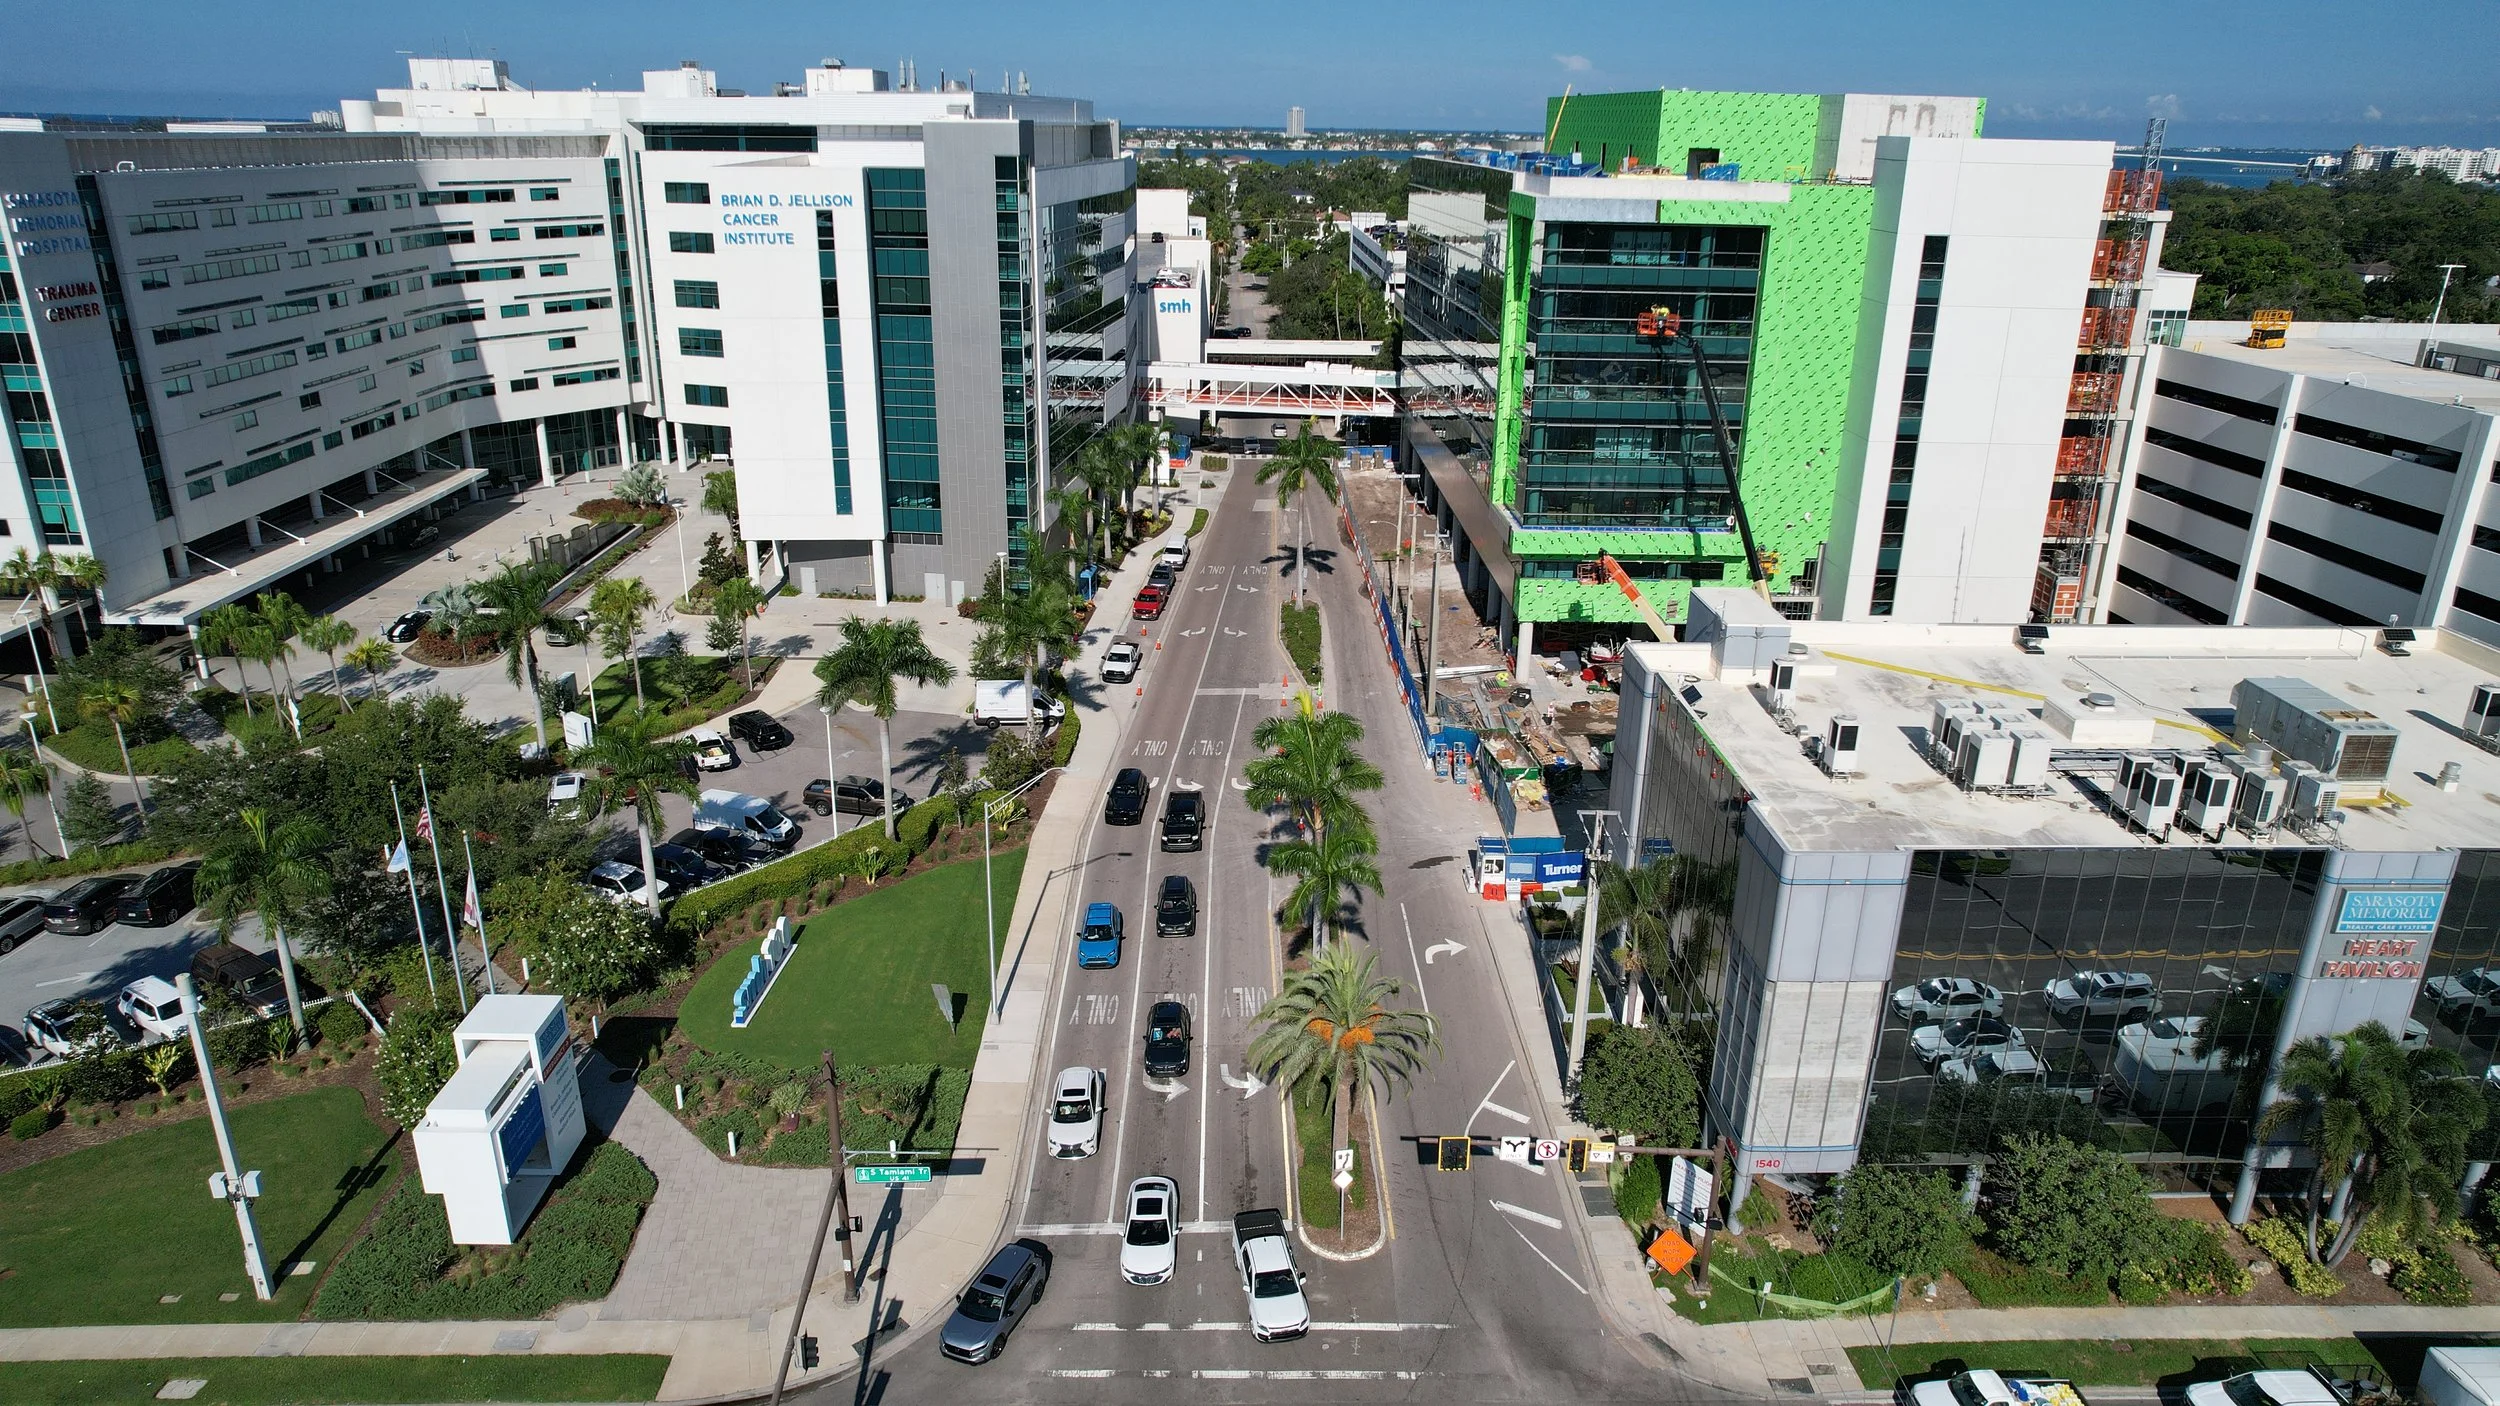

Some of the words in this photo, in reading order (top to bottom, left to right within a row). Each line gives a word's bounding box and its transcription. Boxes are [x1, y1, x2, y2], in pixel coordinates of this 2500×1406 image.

[4, 191, 80, 209] SARASOTA
[721, 194, 763, 207] BRIAN
[769, 194, 783, 207] D.
[788, 194, 853, 207] JELLISON
[11, 214, 85, 233] MEMORIAL
[723, 213, 779, 226] CANCER
[17, 237, 91, 256] HOSPITAL
[724, 232, 795, 245] INSTITUTE
[35, 281, 98, 302] TRAUMA
[46, 302, 101, 322] CENTER
[1159, 298, 1191, 313] smh
[1131, 740, 1168, 756] ONLY
[1188, 740, 1224, 756] ONLY
[1542, 863, 1582, 876] Turner
[2352, 895, 2436, 908] SARASOTA
[2348, 907, 2433, 919] MEMORIAL
[2344, 939, 2418, 957] HEART
[2323, 960, 2422, 978] PAVILION
[1069, 995, 1120, 1025] ONLY
[1755, 1159, 1781, 1168] 1540
[870, 1168, 876, 1176] S
[880, 1168, 915, 1176] Tamiami
